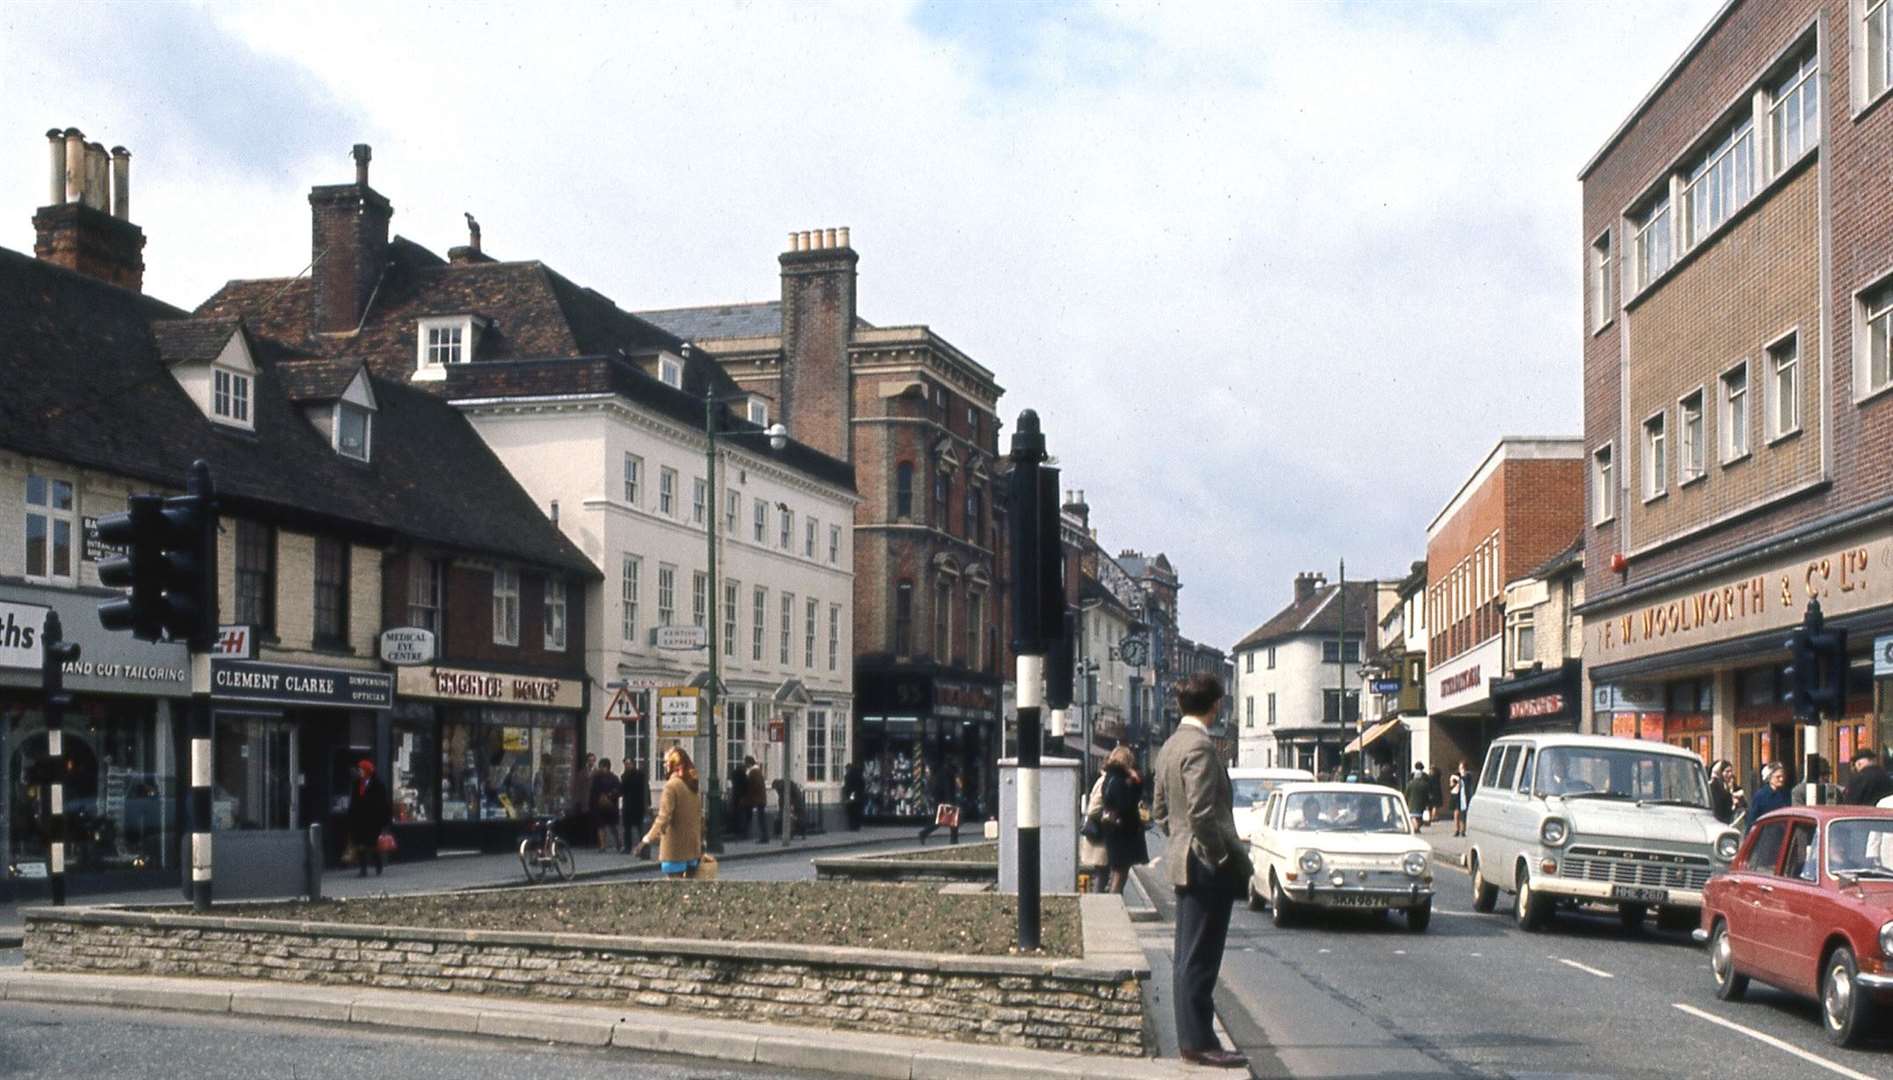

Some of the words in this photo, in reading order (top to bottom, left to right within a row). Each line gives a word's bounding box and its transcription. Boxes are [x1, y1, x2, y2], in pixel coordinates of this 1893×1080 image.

[1604, 617, 1614, 648] F.
[1621, 614, 1636, 644] W.
[1642, 575, 1764, 640] WOOLWORTH
[1780, 574, 1793, 607] &
[386, 632, 427, 642] MEDICAL
[397, 642, 414, 651] EYE
[388, 651, 424, 661] CENTRE
[97, 663, 120, 677] CUT
[124, 665, 185, 682] TAILORING
[216, 670, 279, 690] CLEMENT
[285, 676, 334, 694] CLARKE
